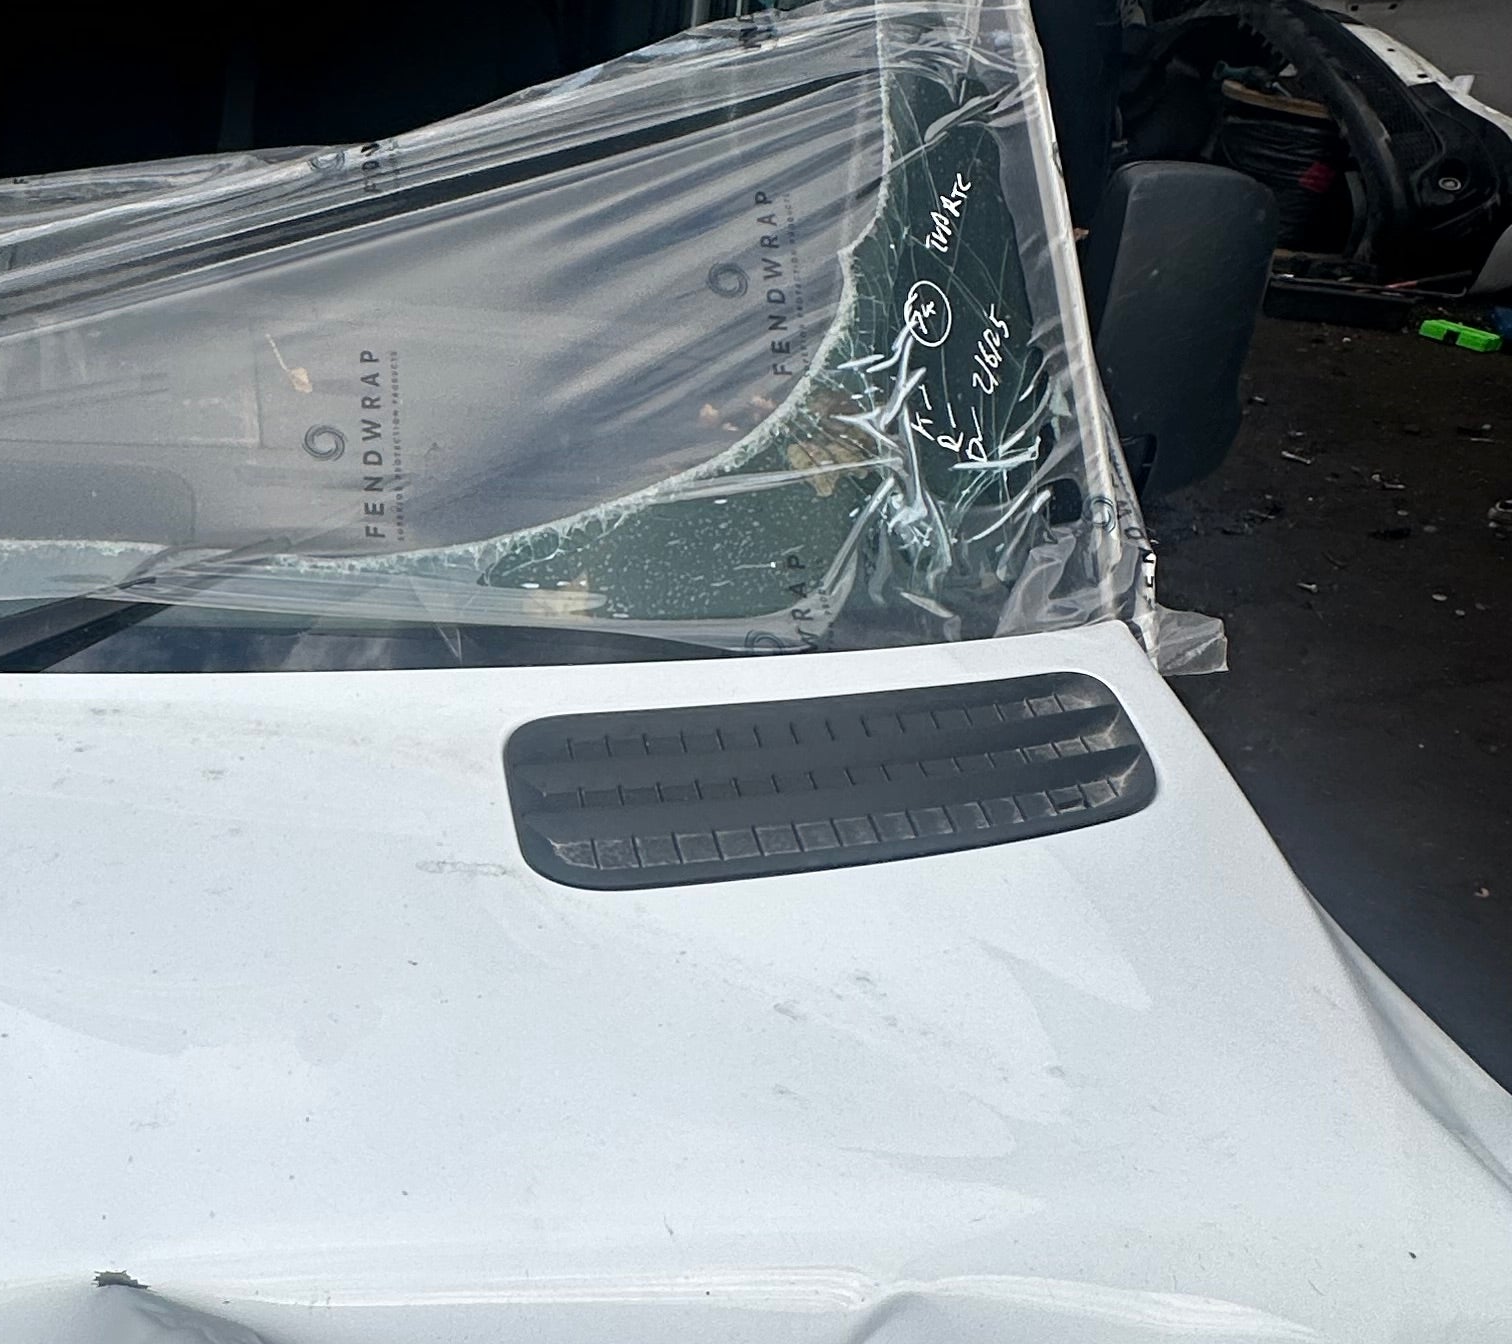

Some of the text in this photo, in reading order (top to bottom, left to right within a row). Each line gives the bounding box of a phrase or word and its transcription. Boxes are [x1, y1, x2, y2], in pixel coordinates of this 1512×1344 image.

[754, 191, 793, 376] FENDWRAP
[359, 349, 386, 539] FENDWRAP
[787, 554, 819, 650] WRAP
